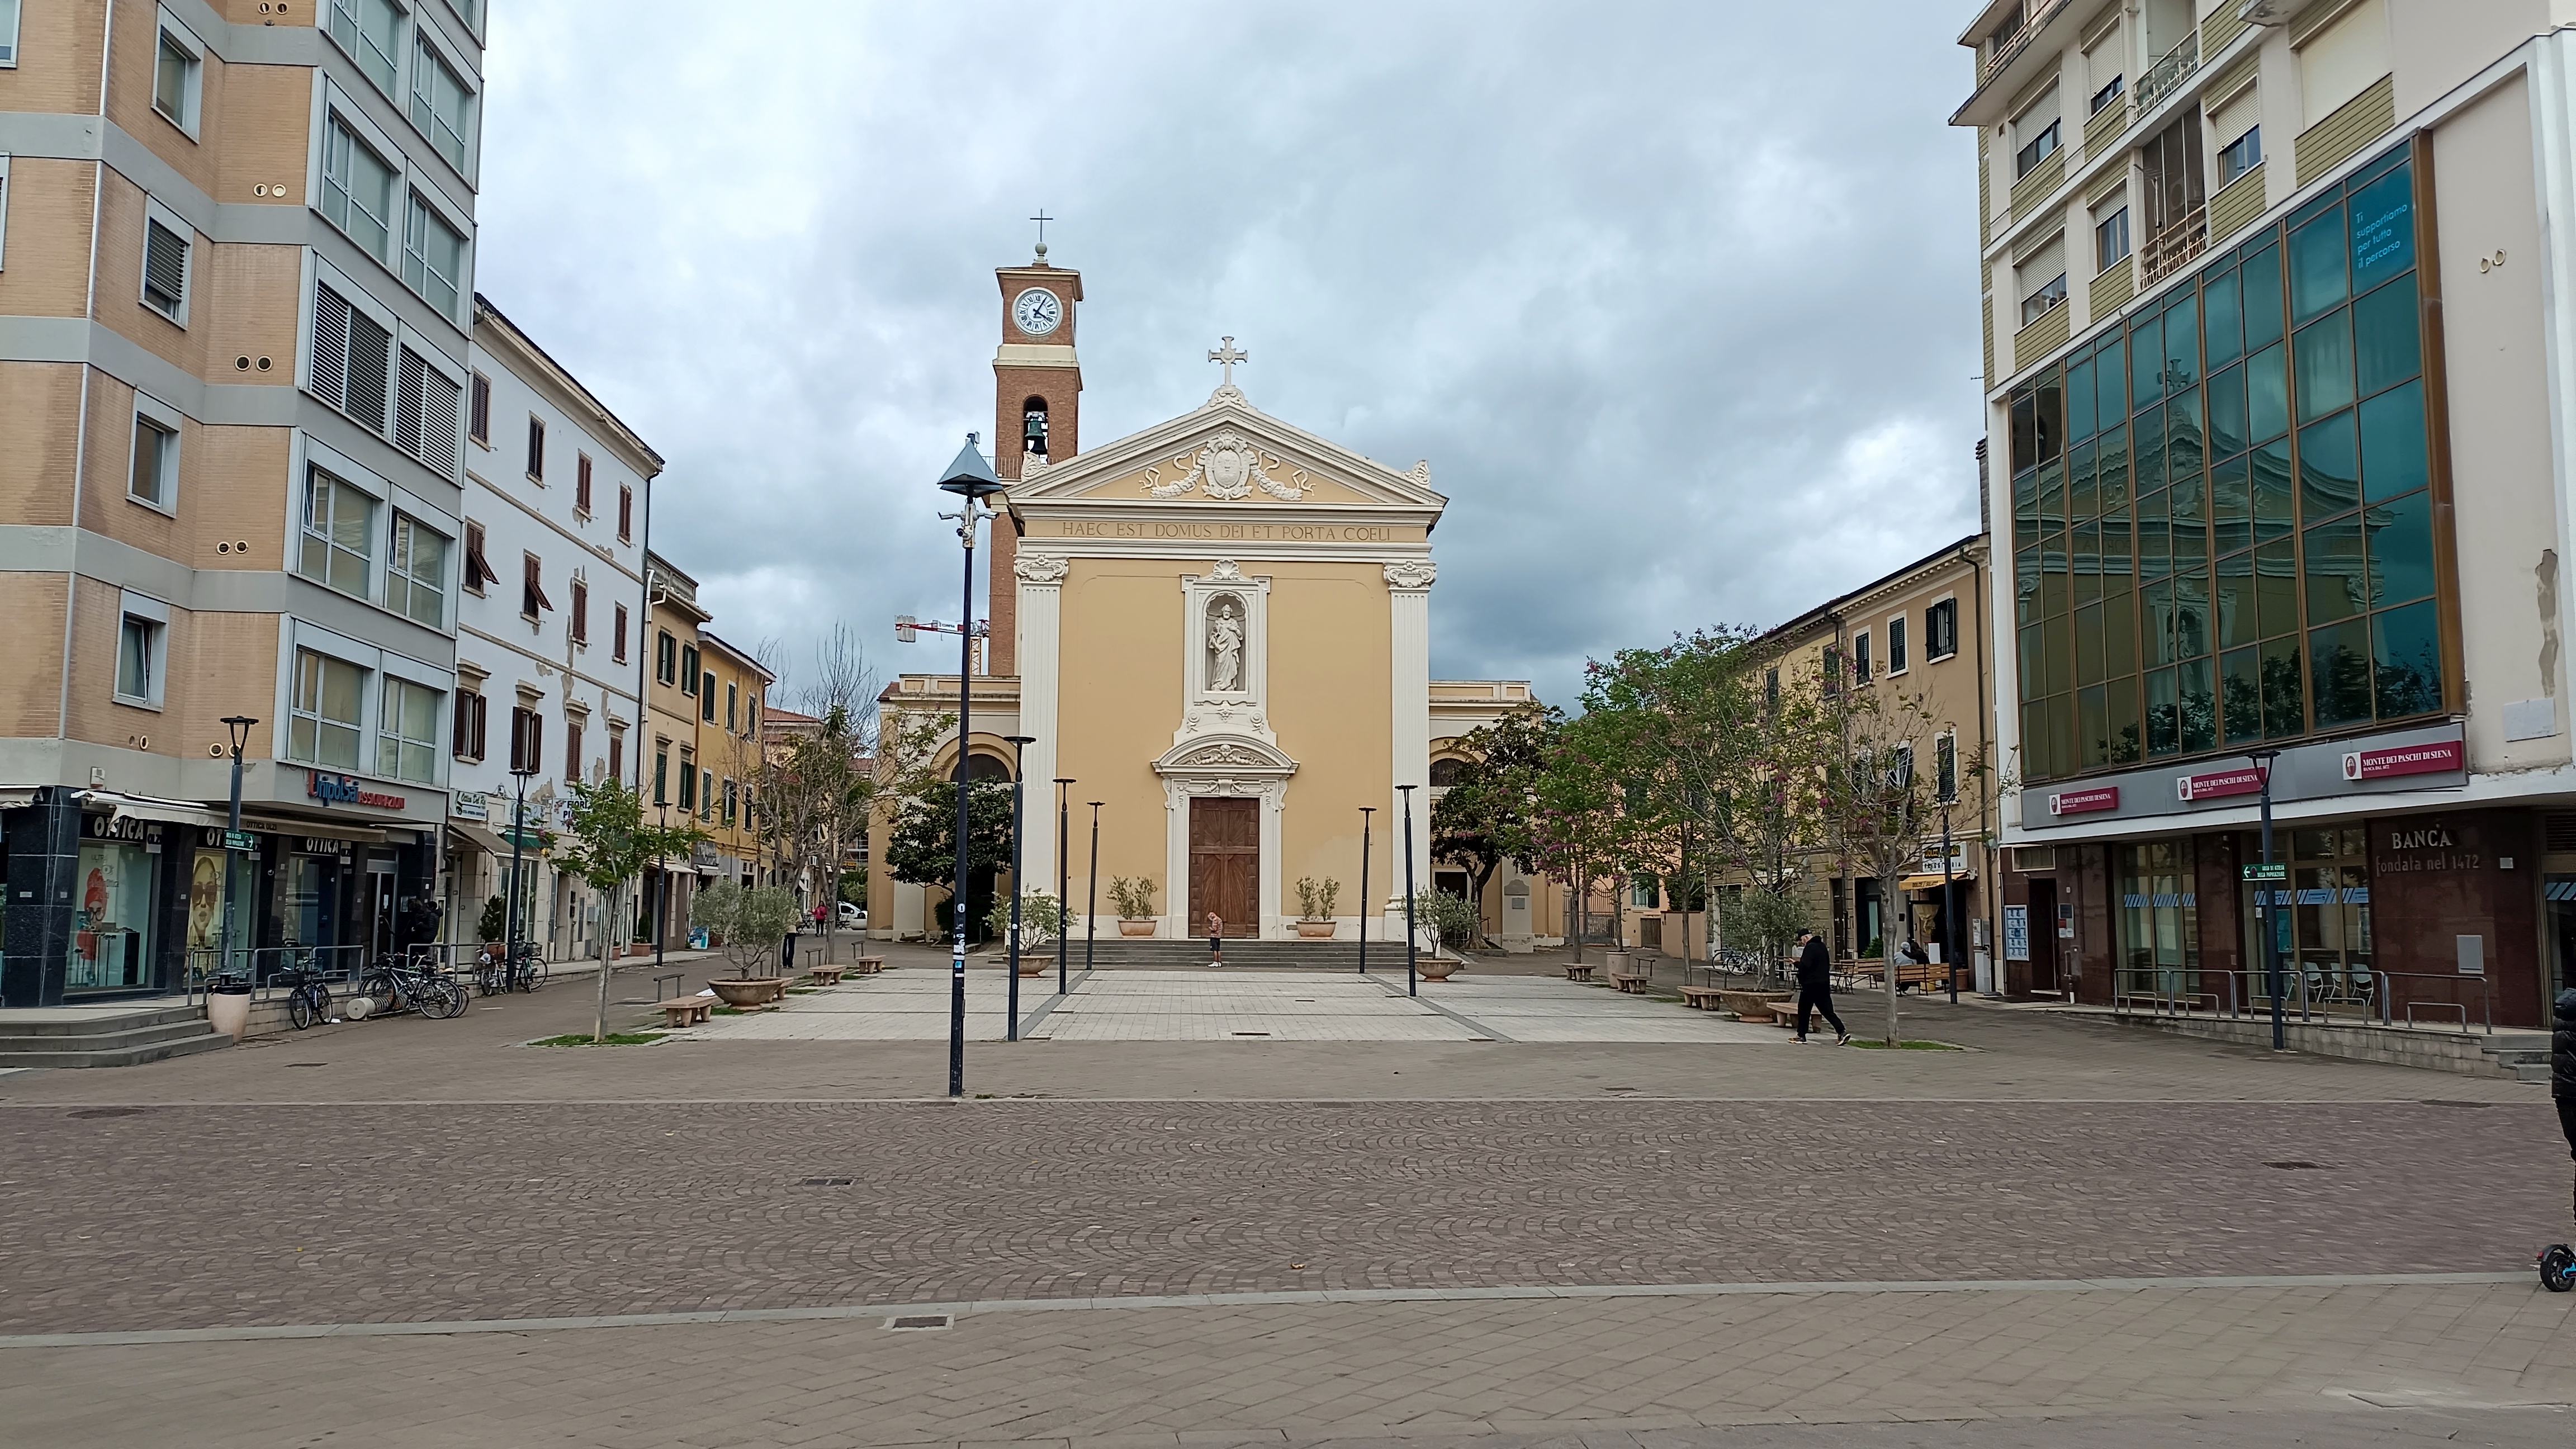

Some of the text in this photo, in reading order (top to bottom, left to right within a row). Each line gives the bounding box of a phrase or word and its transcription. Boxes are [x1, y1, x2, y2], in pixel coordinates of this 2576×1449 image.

[2356, 212, 2363, 224] Ti
[2357, 205, 2407, 238] supportiamo
[2358, 229, 2392, 255] per tutto
[2359, 241, 2400, 269] il percorso
[1063, 522, 1390, 541] HAEC EST DOMUS DEI ET PORTA COELI
[2363, 757, 2386, 767] MONTE
[2386, 756, 2397, 764] DEI
[2398, 752, 2422, 763] PASCHI
[2431, 749, 2452, 759] SIENA
[308, 770, 359, 807] UnipolSai
[2193, 780, 2210, 789] MONTE
[2219, 776, 2236, 785] PASCHI
[306, 837, 338, 854] OTTICA
[2392, 830, 2453, 849] BANCA
[2376, 851, 2480, 877] fondata nel 1472
